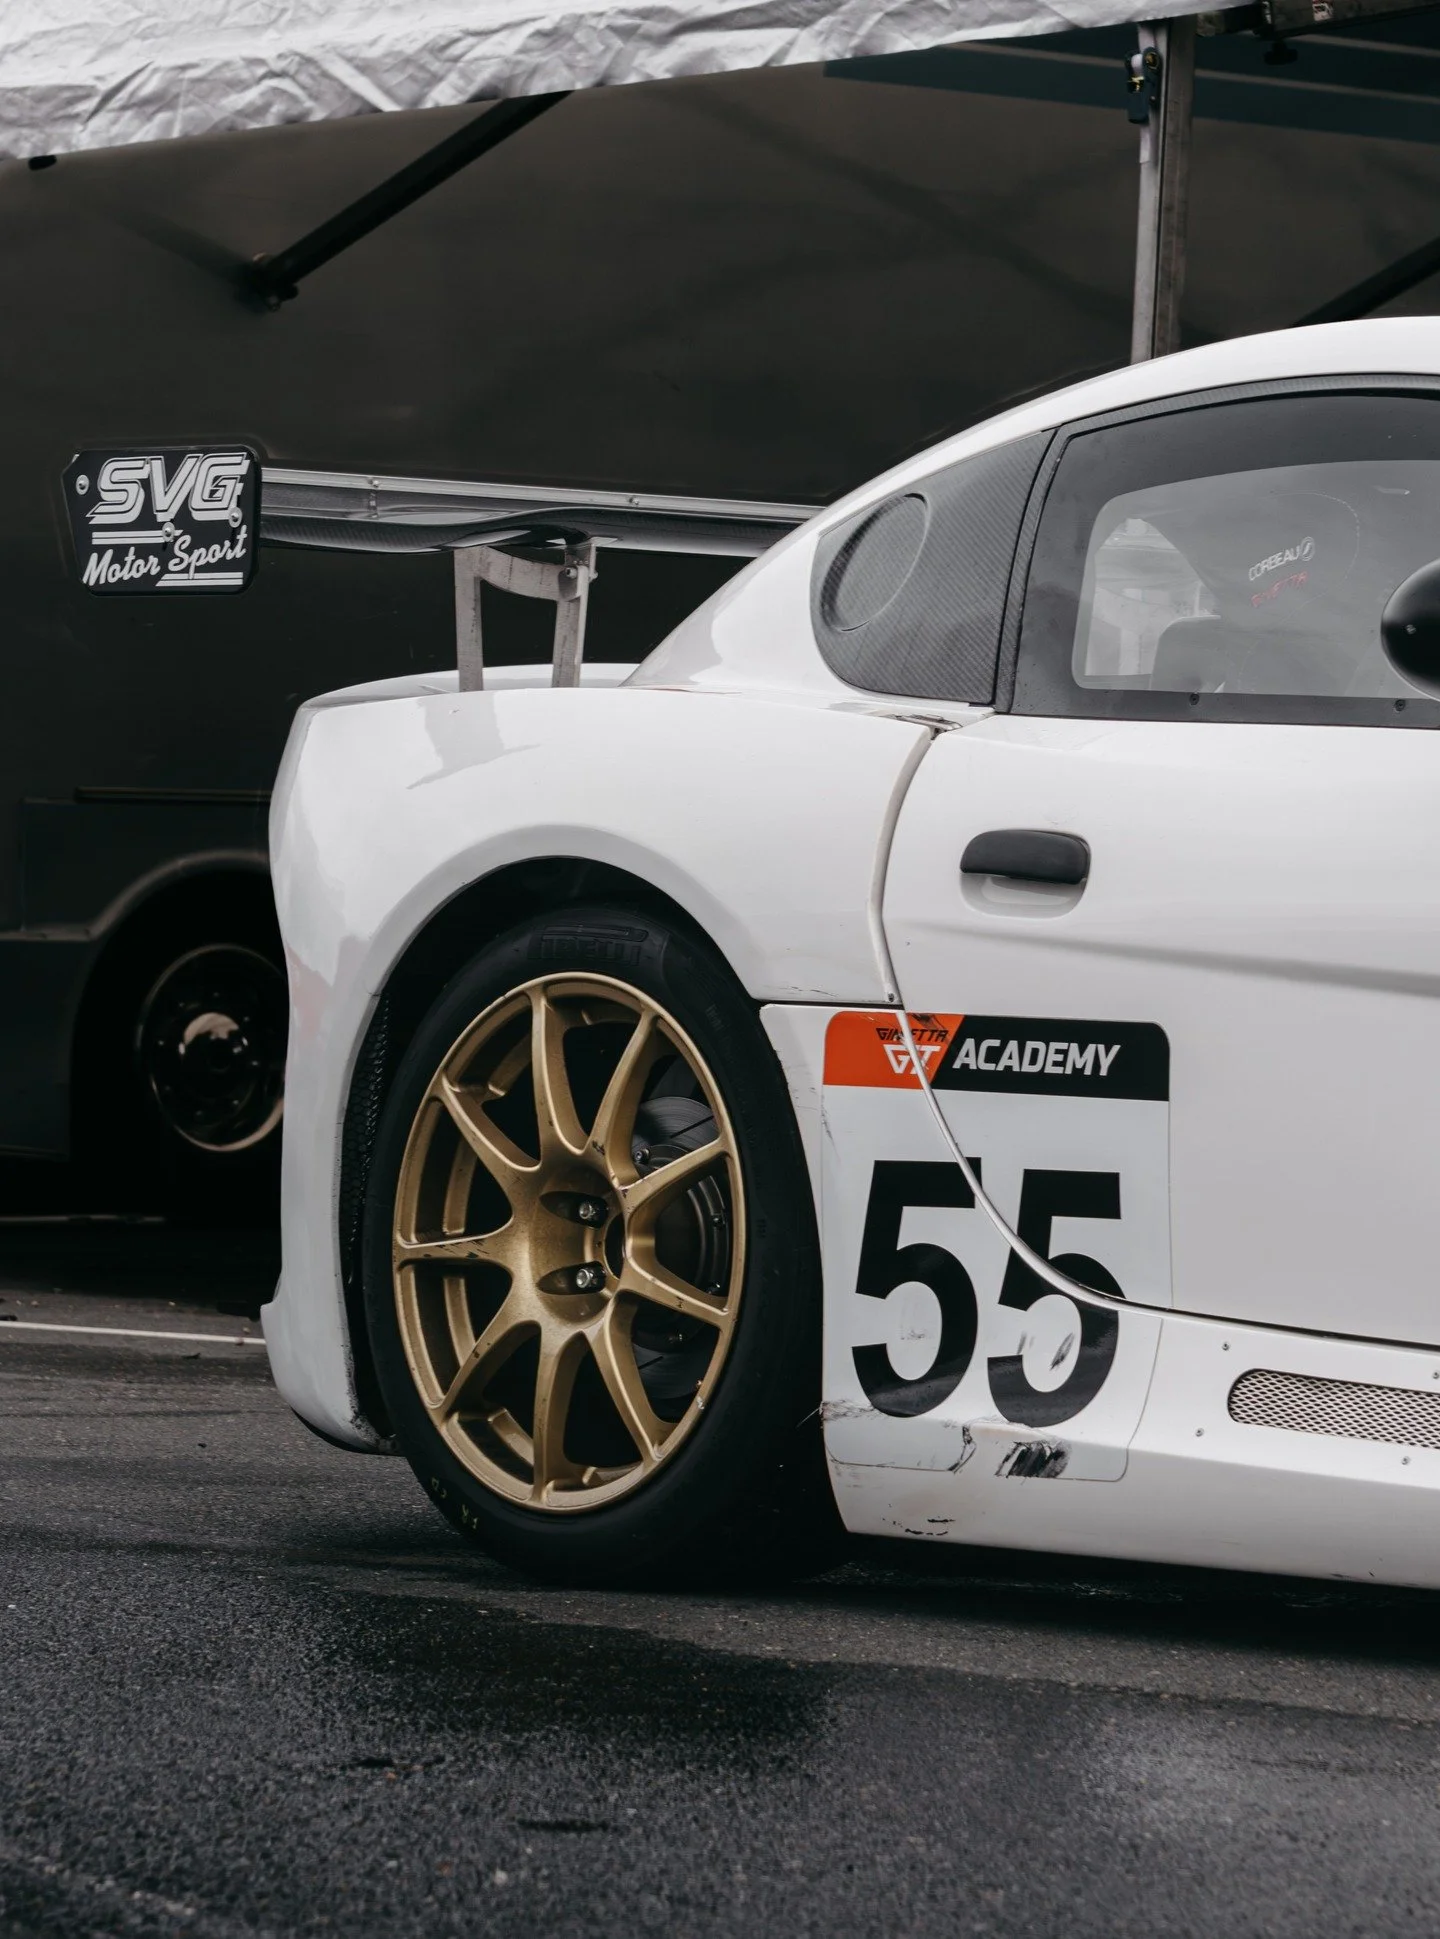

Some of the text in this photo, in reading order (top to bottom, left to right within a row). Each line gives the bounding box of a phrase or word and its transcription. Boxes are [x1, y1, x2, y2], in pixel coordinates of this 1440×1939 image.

[86, 452, 250, 525] SVG
[82, 525, 248, 586] Motor Sport
[1248, 545, 1301, 581] CORBEAU
[883, 1037, 1121, 1077] GT ACADEMY
[851, 1156, 1127, 1428] 55
